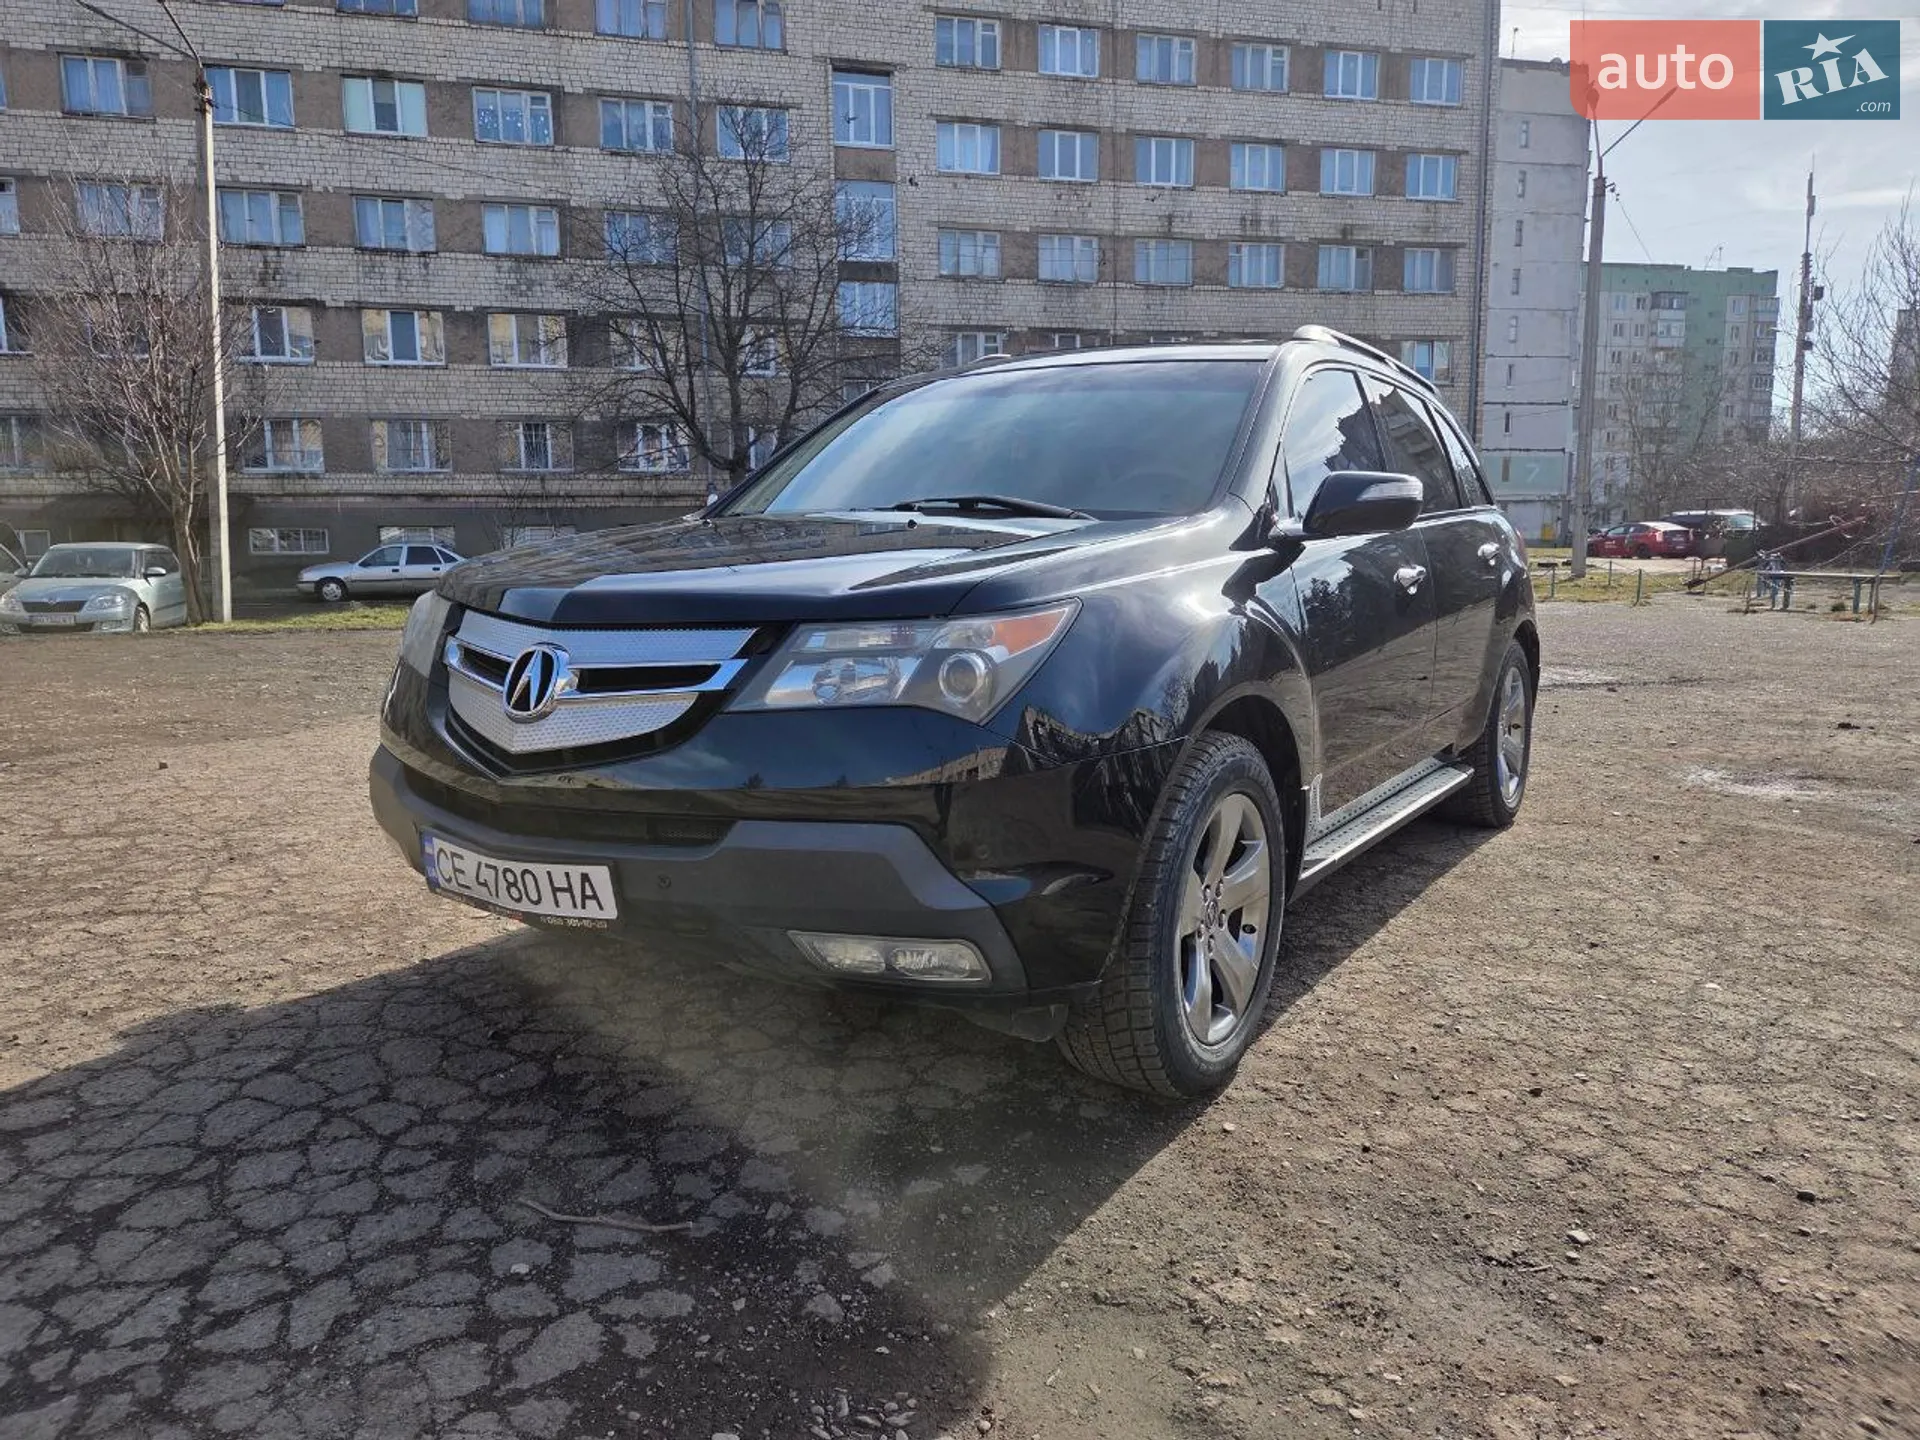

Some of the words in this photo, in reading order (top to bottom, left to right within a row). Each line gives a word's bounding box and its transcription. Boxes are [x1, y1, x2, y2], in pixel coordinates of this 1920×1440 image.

[436, 847, 471, 890] CE
[475, 861, 542, 906] 4780
[547, 870, 604, 911] HA
